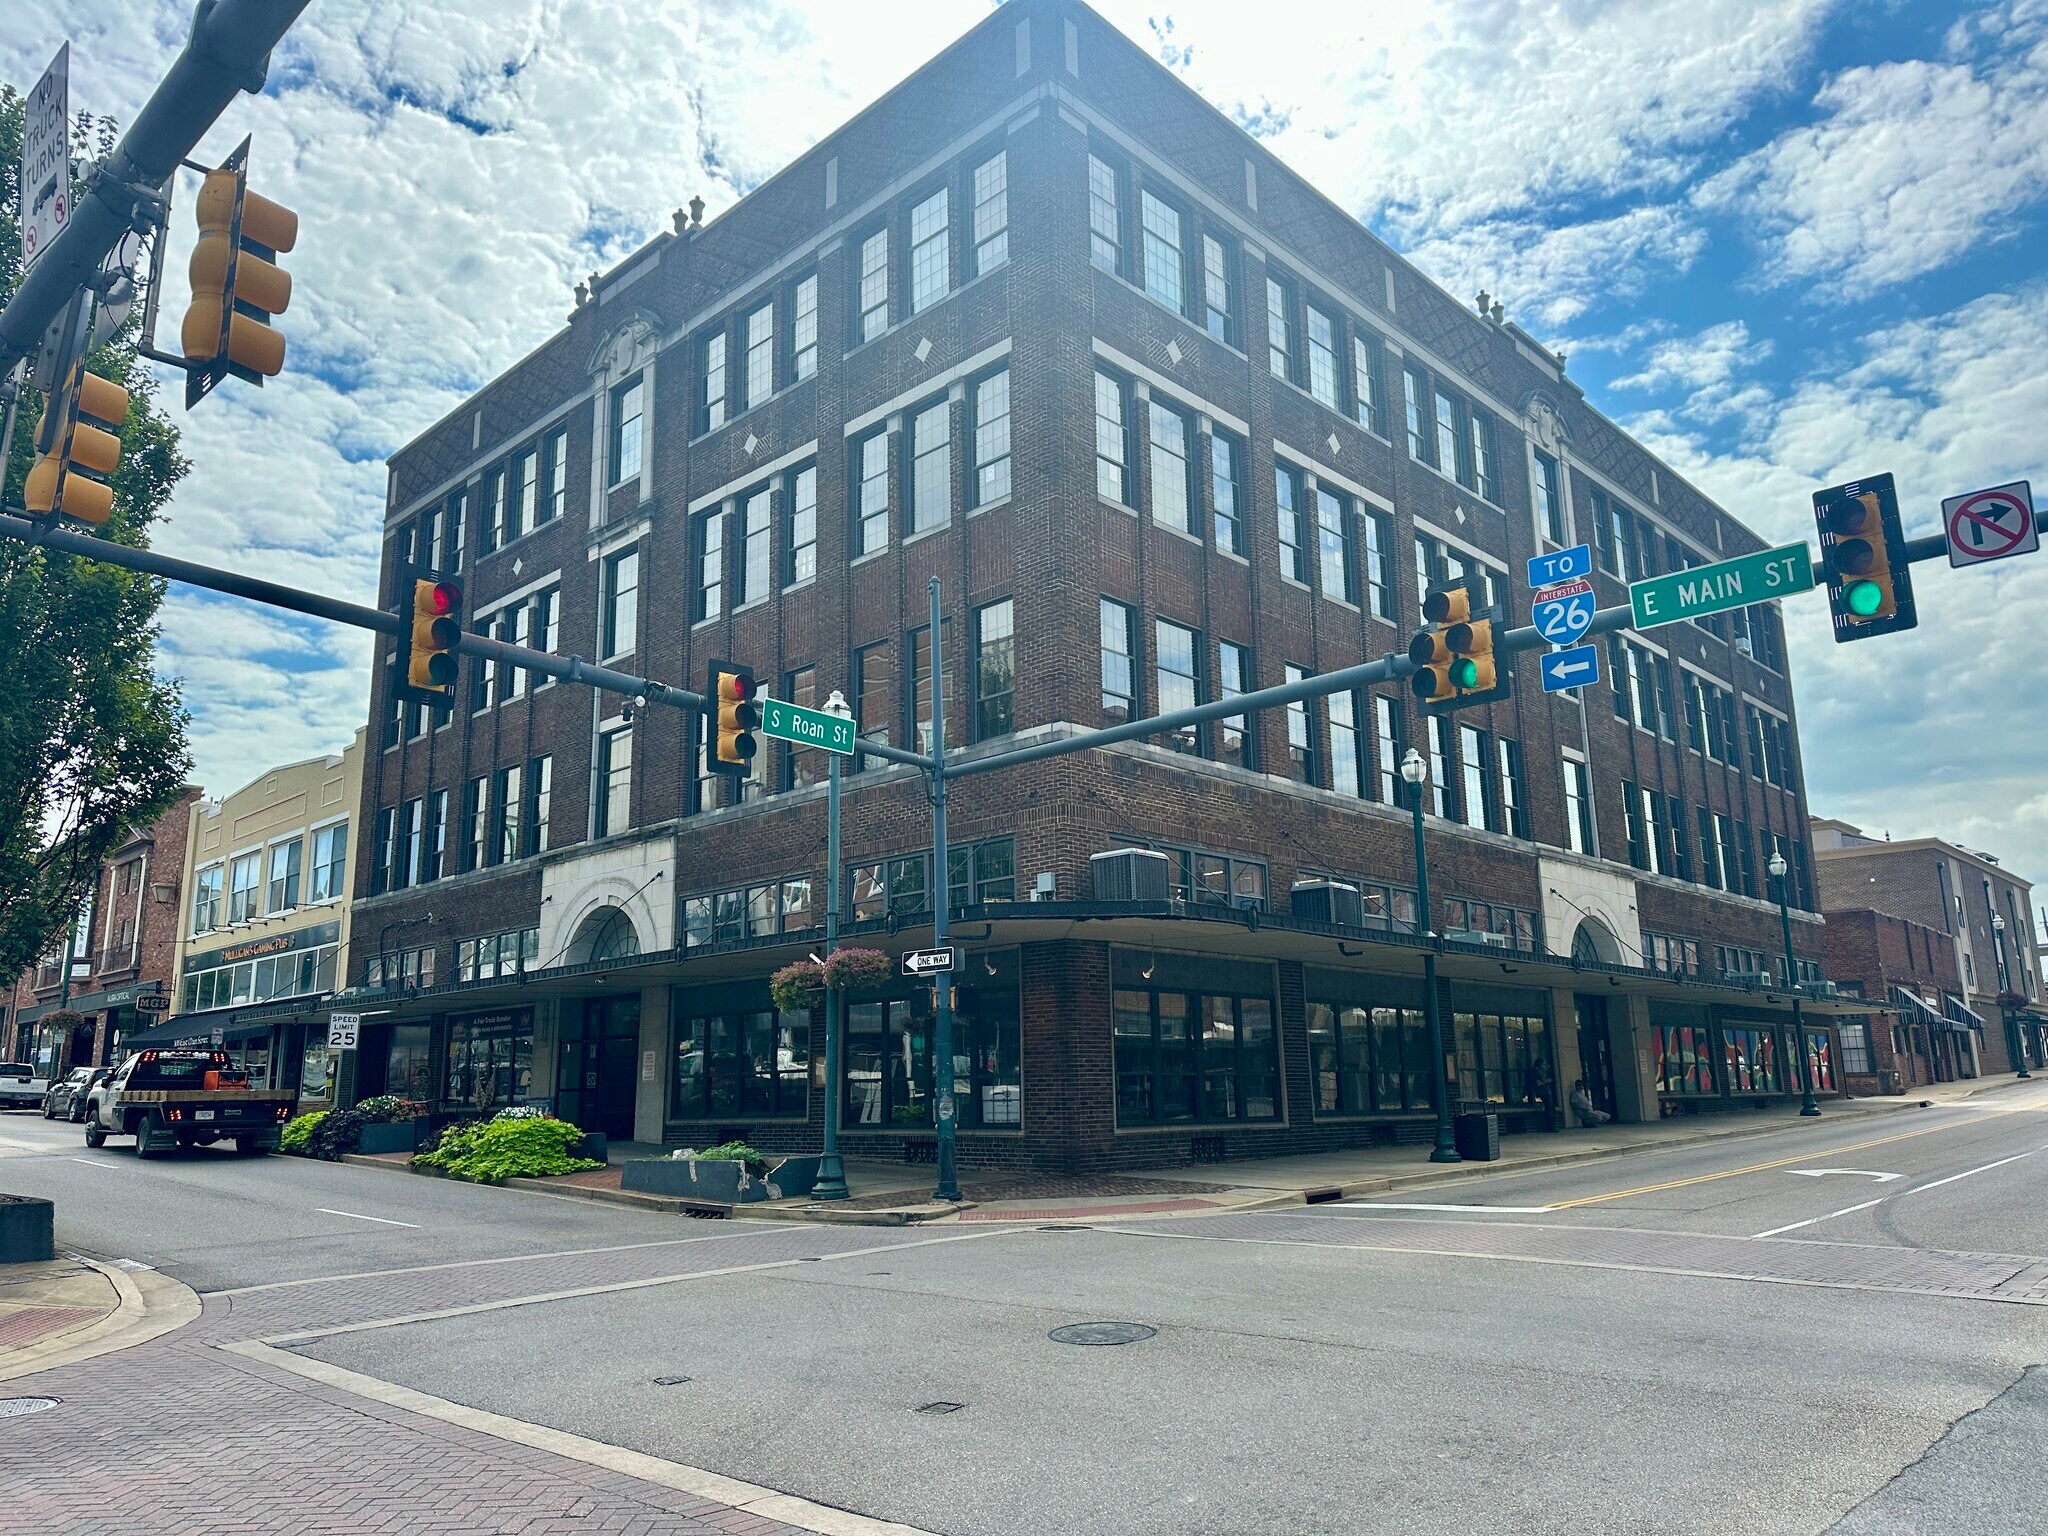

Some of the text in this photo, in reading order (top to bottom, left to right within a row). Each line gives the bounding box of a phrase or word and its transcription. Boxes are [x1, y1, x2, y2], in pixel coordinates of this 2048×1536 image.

[38, 74, 53, 111] NO
[27, 93, 62, 157] TRUCK
[26, 131, 63, 193] TURNS
[1544, 556, 1573, 577] TO
[1541, 584, 1584, 602] INTERSTATE
[1643, 557, 1796, 616] E MAIN ST
[1543, 597, 1590, 637] 26
[771, 709, 848, 745] S Roan St
[917, 954, 948, 966] ONE WAY
[139, 998, 169, 1009] MGP
[332, 1015, 358, 1023] SPEED
[330, 1031, 355, 1046] 25
